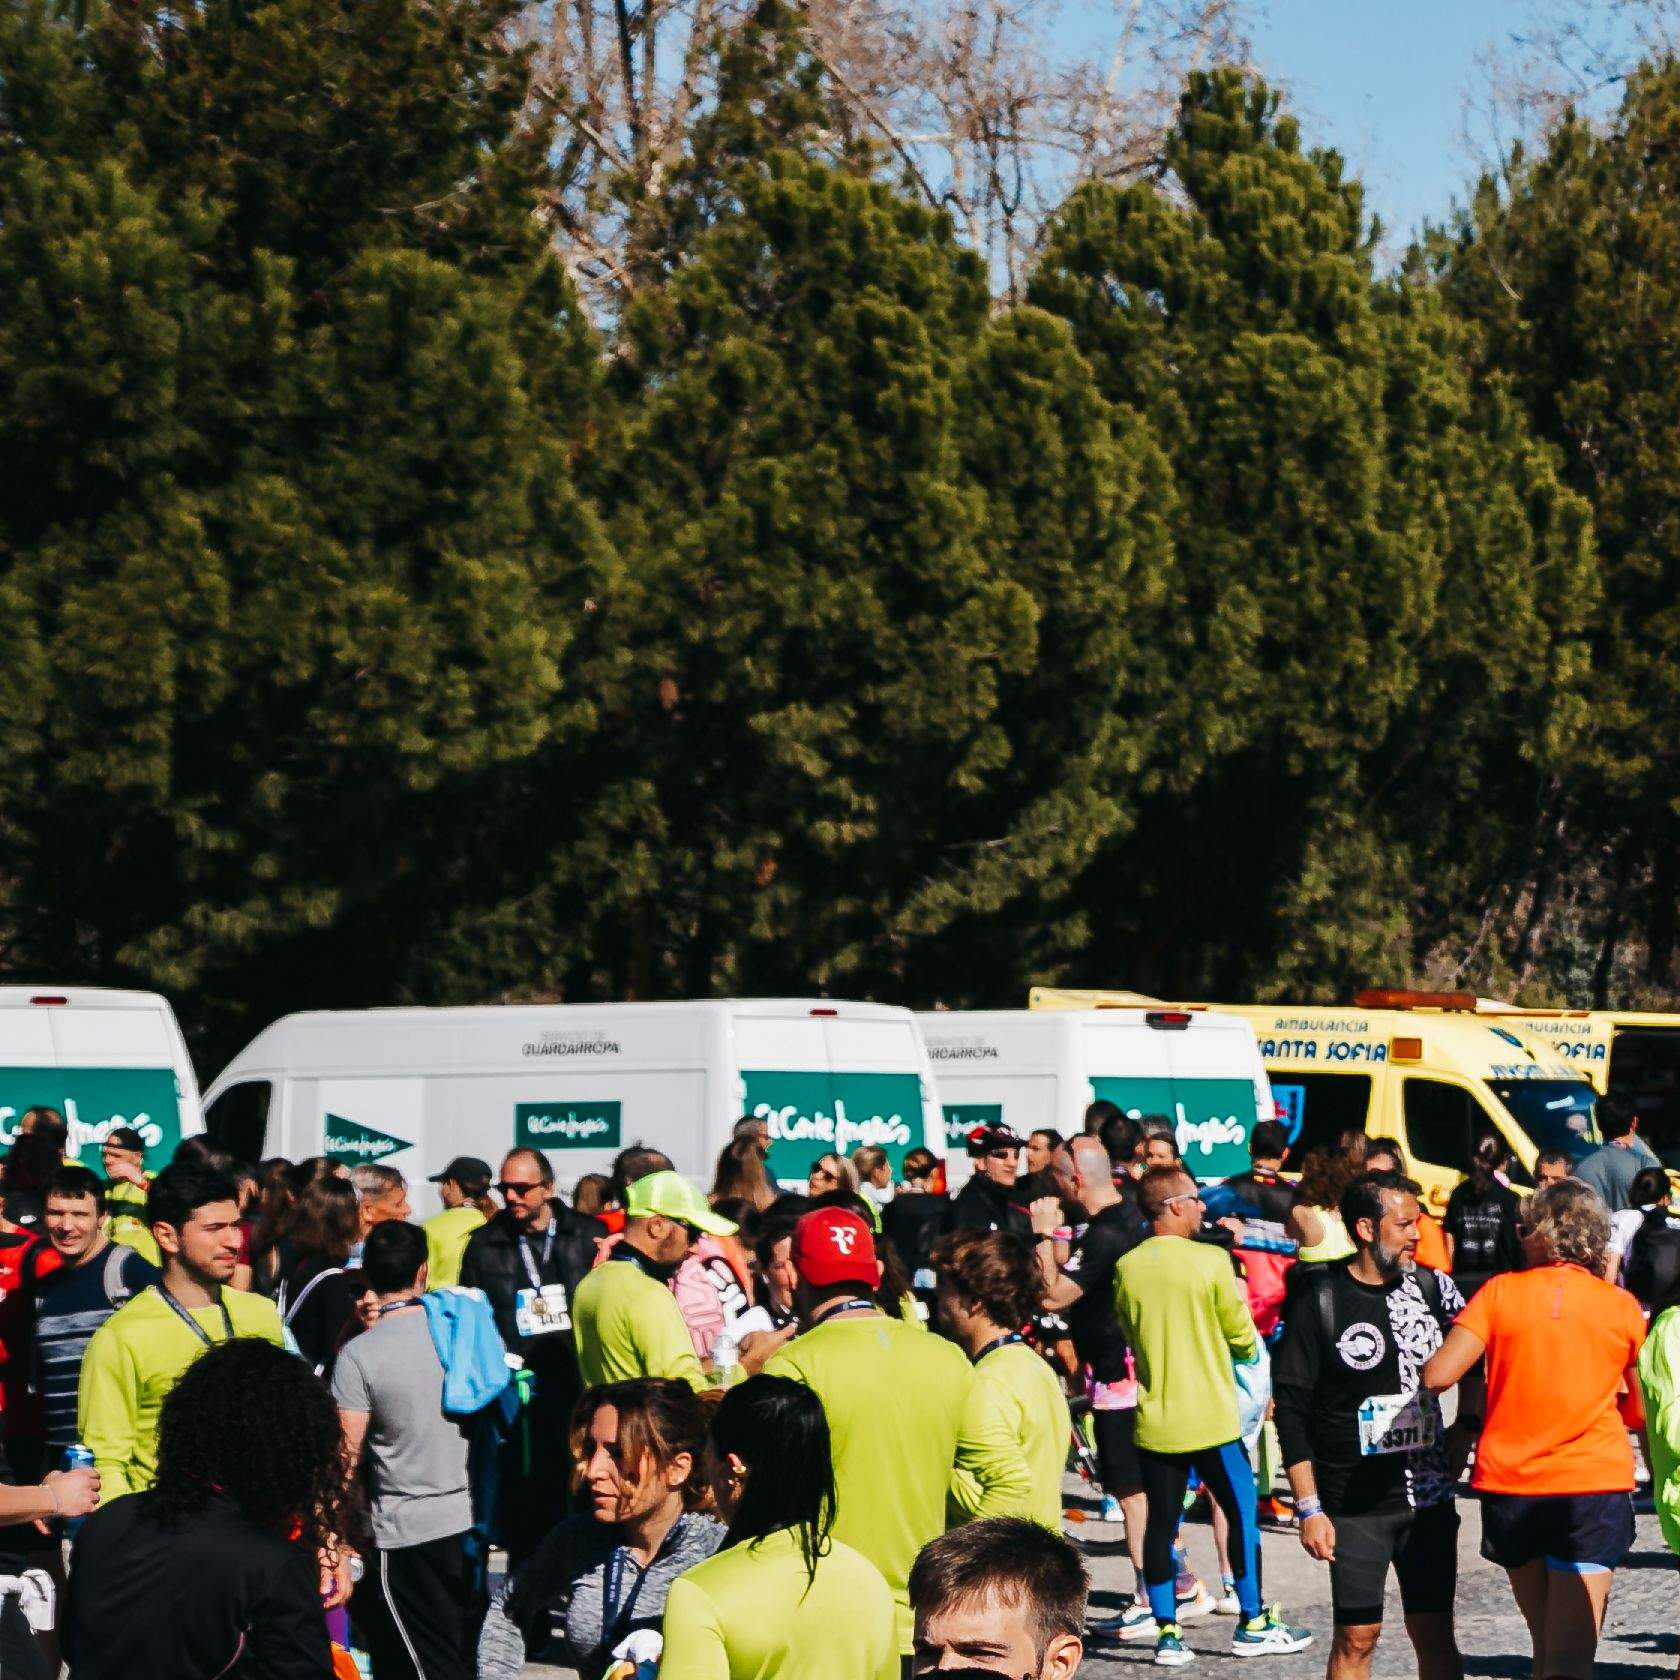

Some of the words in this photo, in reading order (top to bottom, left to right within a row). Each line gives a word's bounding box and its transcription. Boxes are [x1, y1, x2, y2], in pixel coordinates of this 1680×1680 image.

[521, 1041, 622, 1057] GUARDARROPA
[1257, 1037, 1317, 1058] ANTA
[1551, 1040, 1607, 1061] OFIA
